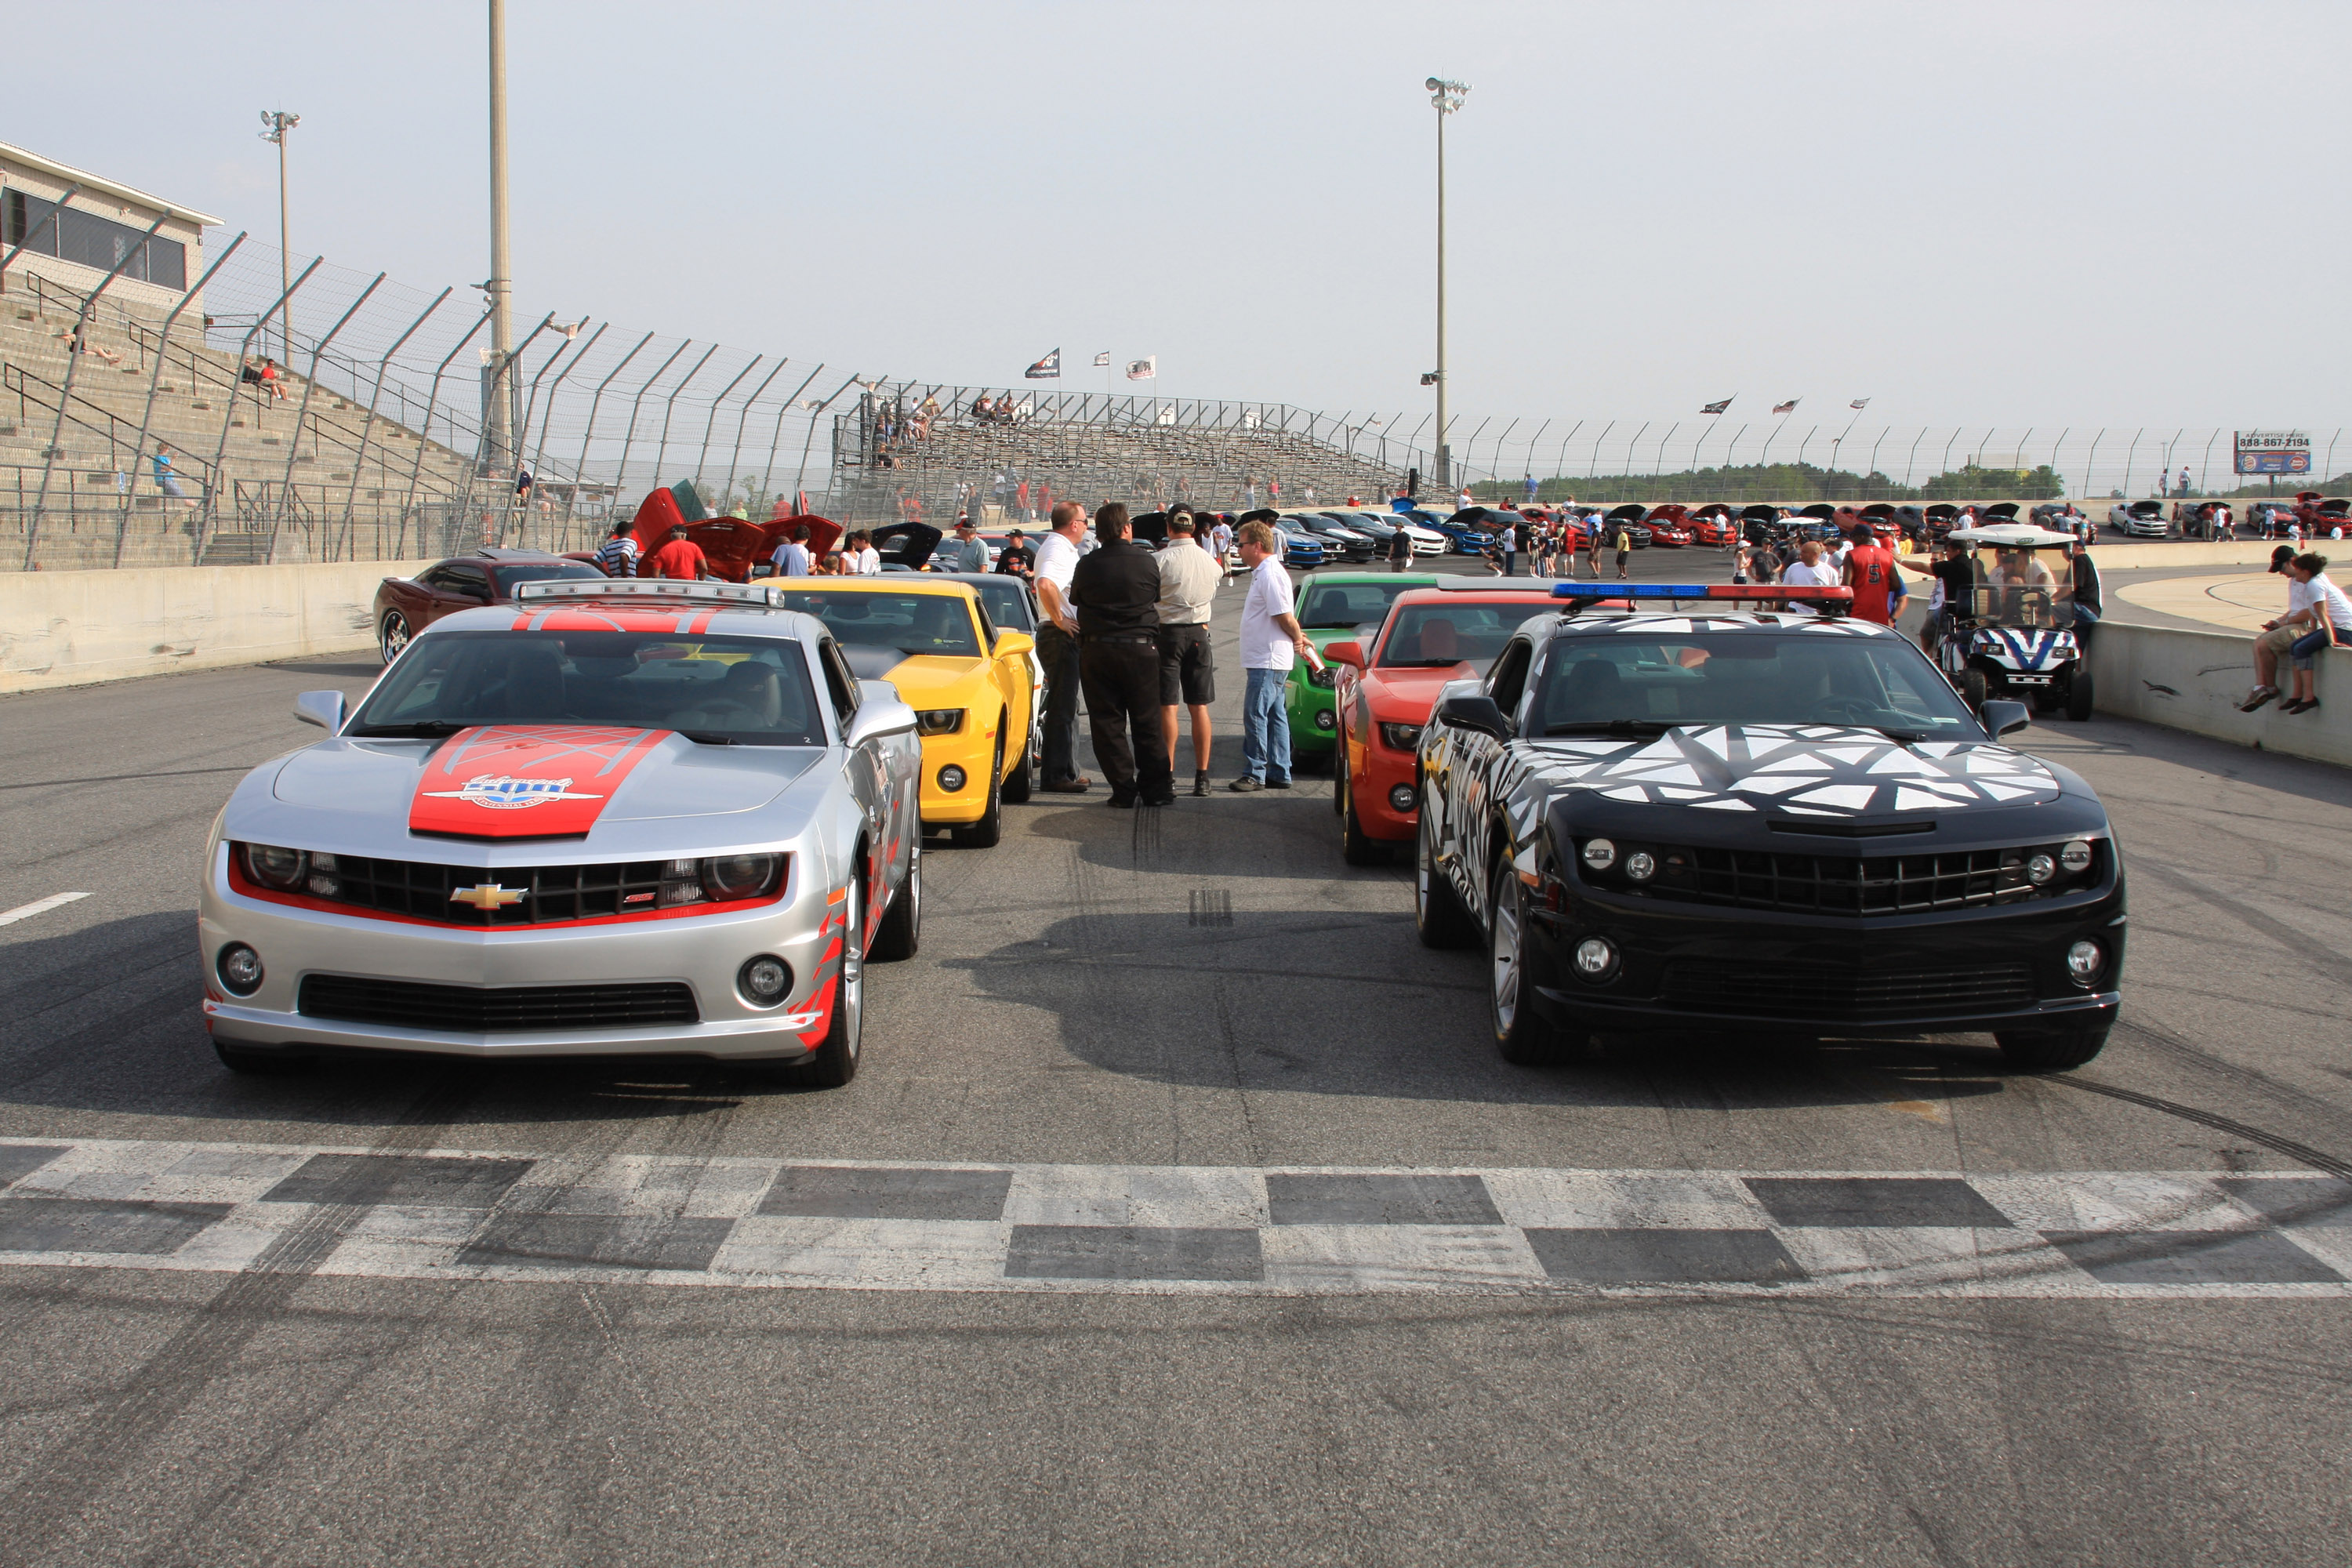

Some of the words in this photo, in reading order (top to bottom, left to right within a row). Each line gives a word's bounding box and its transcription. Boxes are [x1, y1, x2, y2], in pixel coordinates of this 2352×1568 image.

[2240, 438, 2309, 447] 888-867-2194
[1868, 564, 1880, 585] 5
[623, 892, 656, 902] SS
